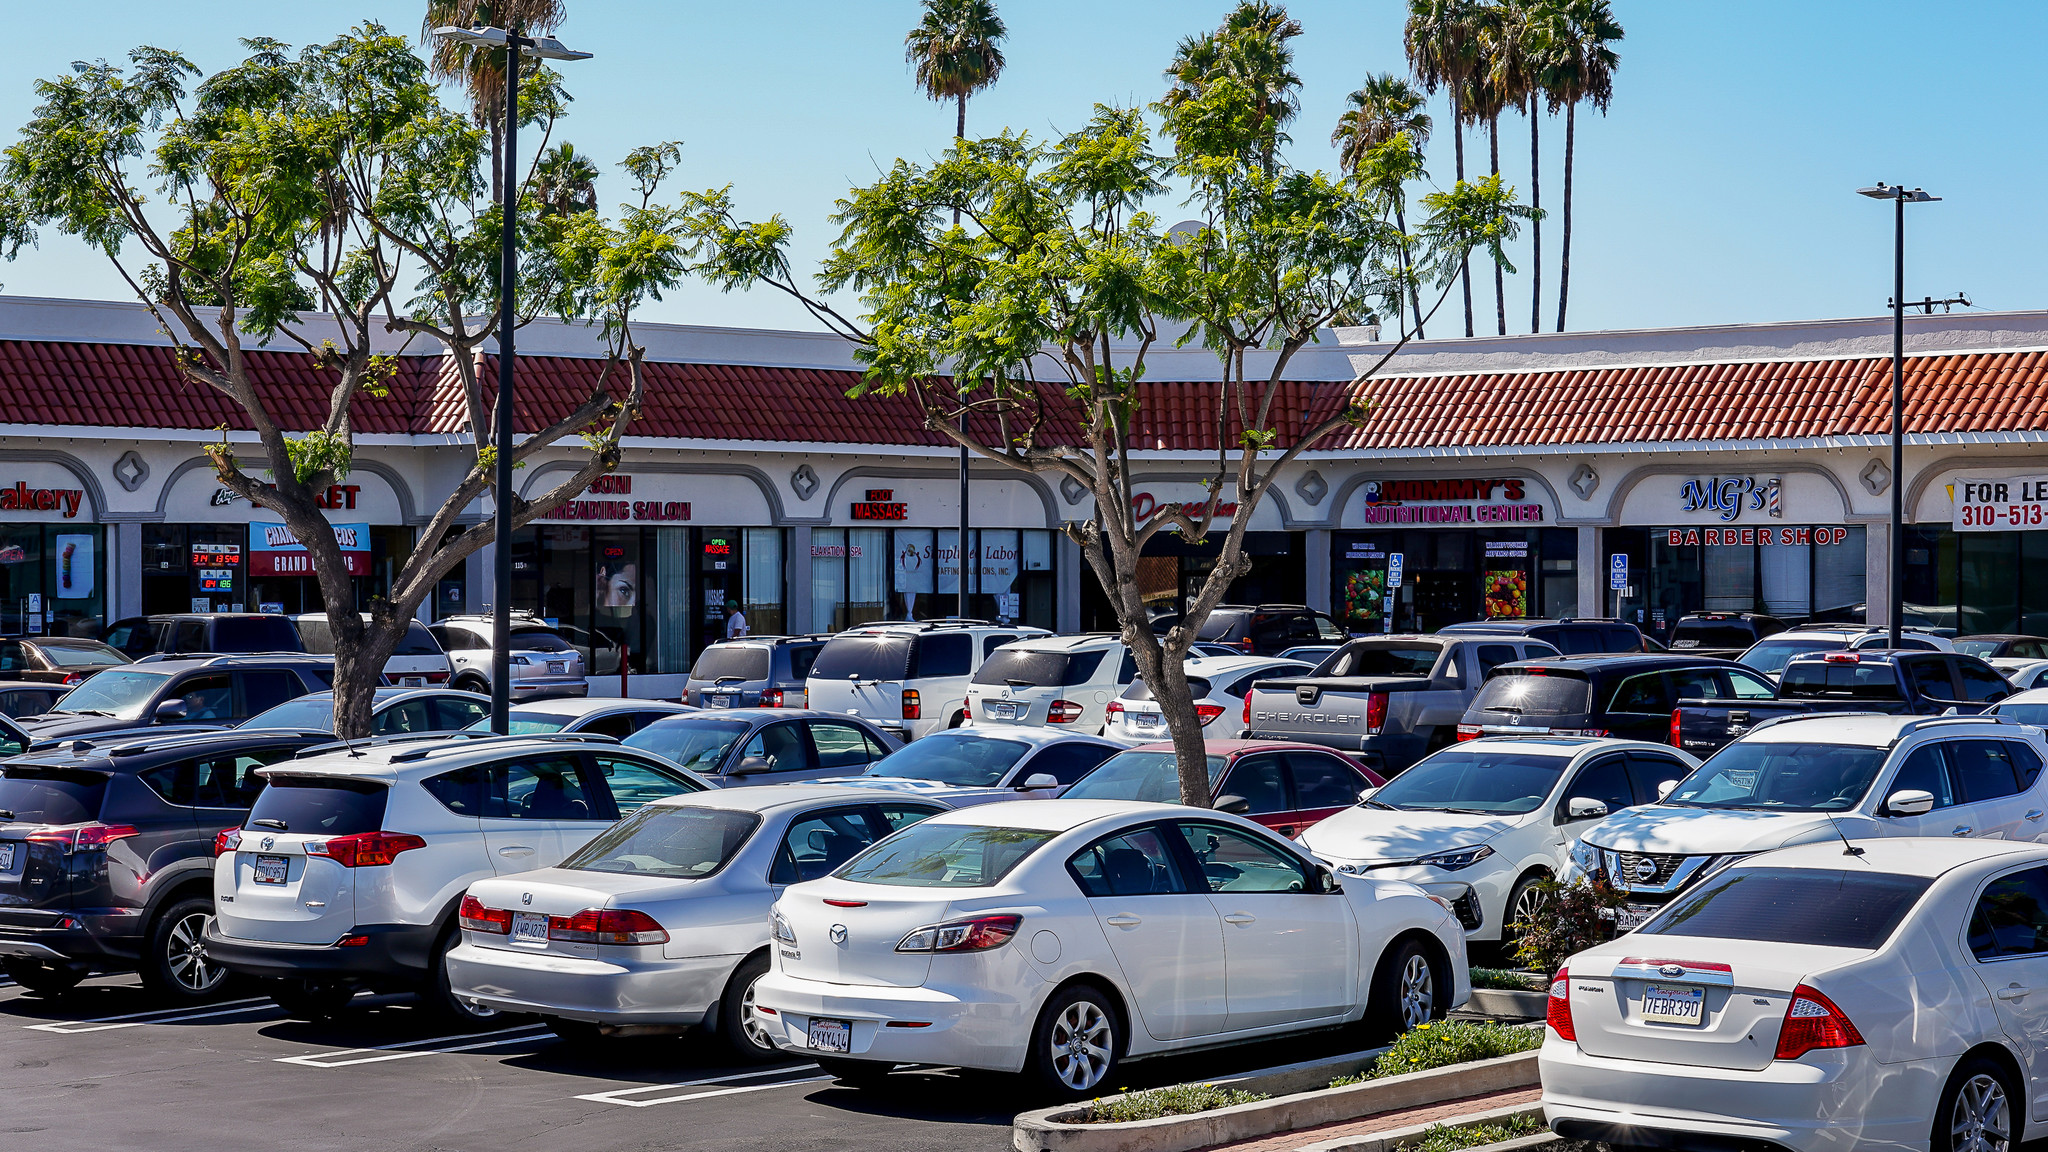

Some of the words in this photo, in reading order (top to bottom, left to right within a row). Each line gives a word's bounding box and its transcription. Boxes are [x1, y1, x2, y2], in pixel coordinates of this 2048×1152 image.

[866, 489, 894, 501] FOOT
[1380, 479, 1527, 501] MOMMY'S
[1964, 482, 2009, 503] FOR
[2021, 481, 2048, 502] LE
[1680, 478, 1768, 522] MG's
[537, 501, 630, 521] READING
[634, 502, 692, 521] SALON
[852, 502, 908, 520] MASSAGE
[1365, 505, 1475, 524] NUTRITIONAL
[1476, 504, 1543, 523] CENTER
[1668, 528, 1774, 546] BARBER
[1780, 527, 1848, 546] SHOP
[605, 547, 624, 556] OPEN
[705, 545, 731, 554] MASSAGE
[850, 546, 863, 557] SPA
[986, 545, 1018, 561] Labor
[274, 556, 307, 572] GRAND
[1255, 711, 1361, 724] CHEVROLET
[1646, 997, 1699, 1018] 7EBR390
[810, 1030, 848, 1049] 6YXY414
